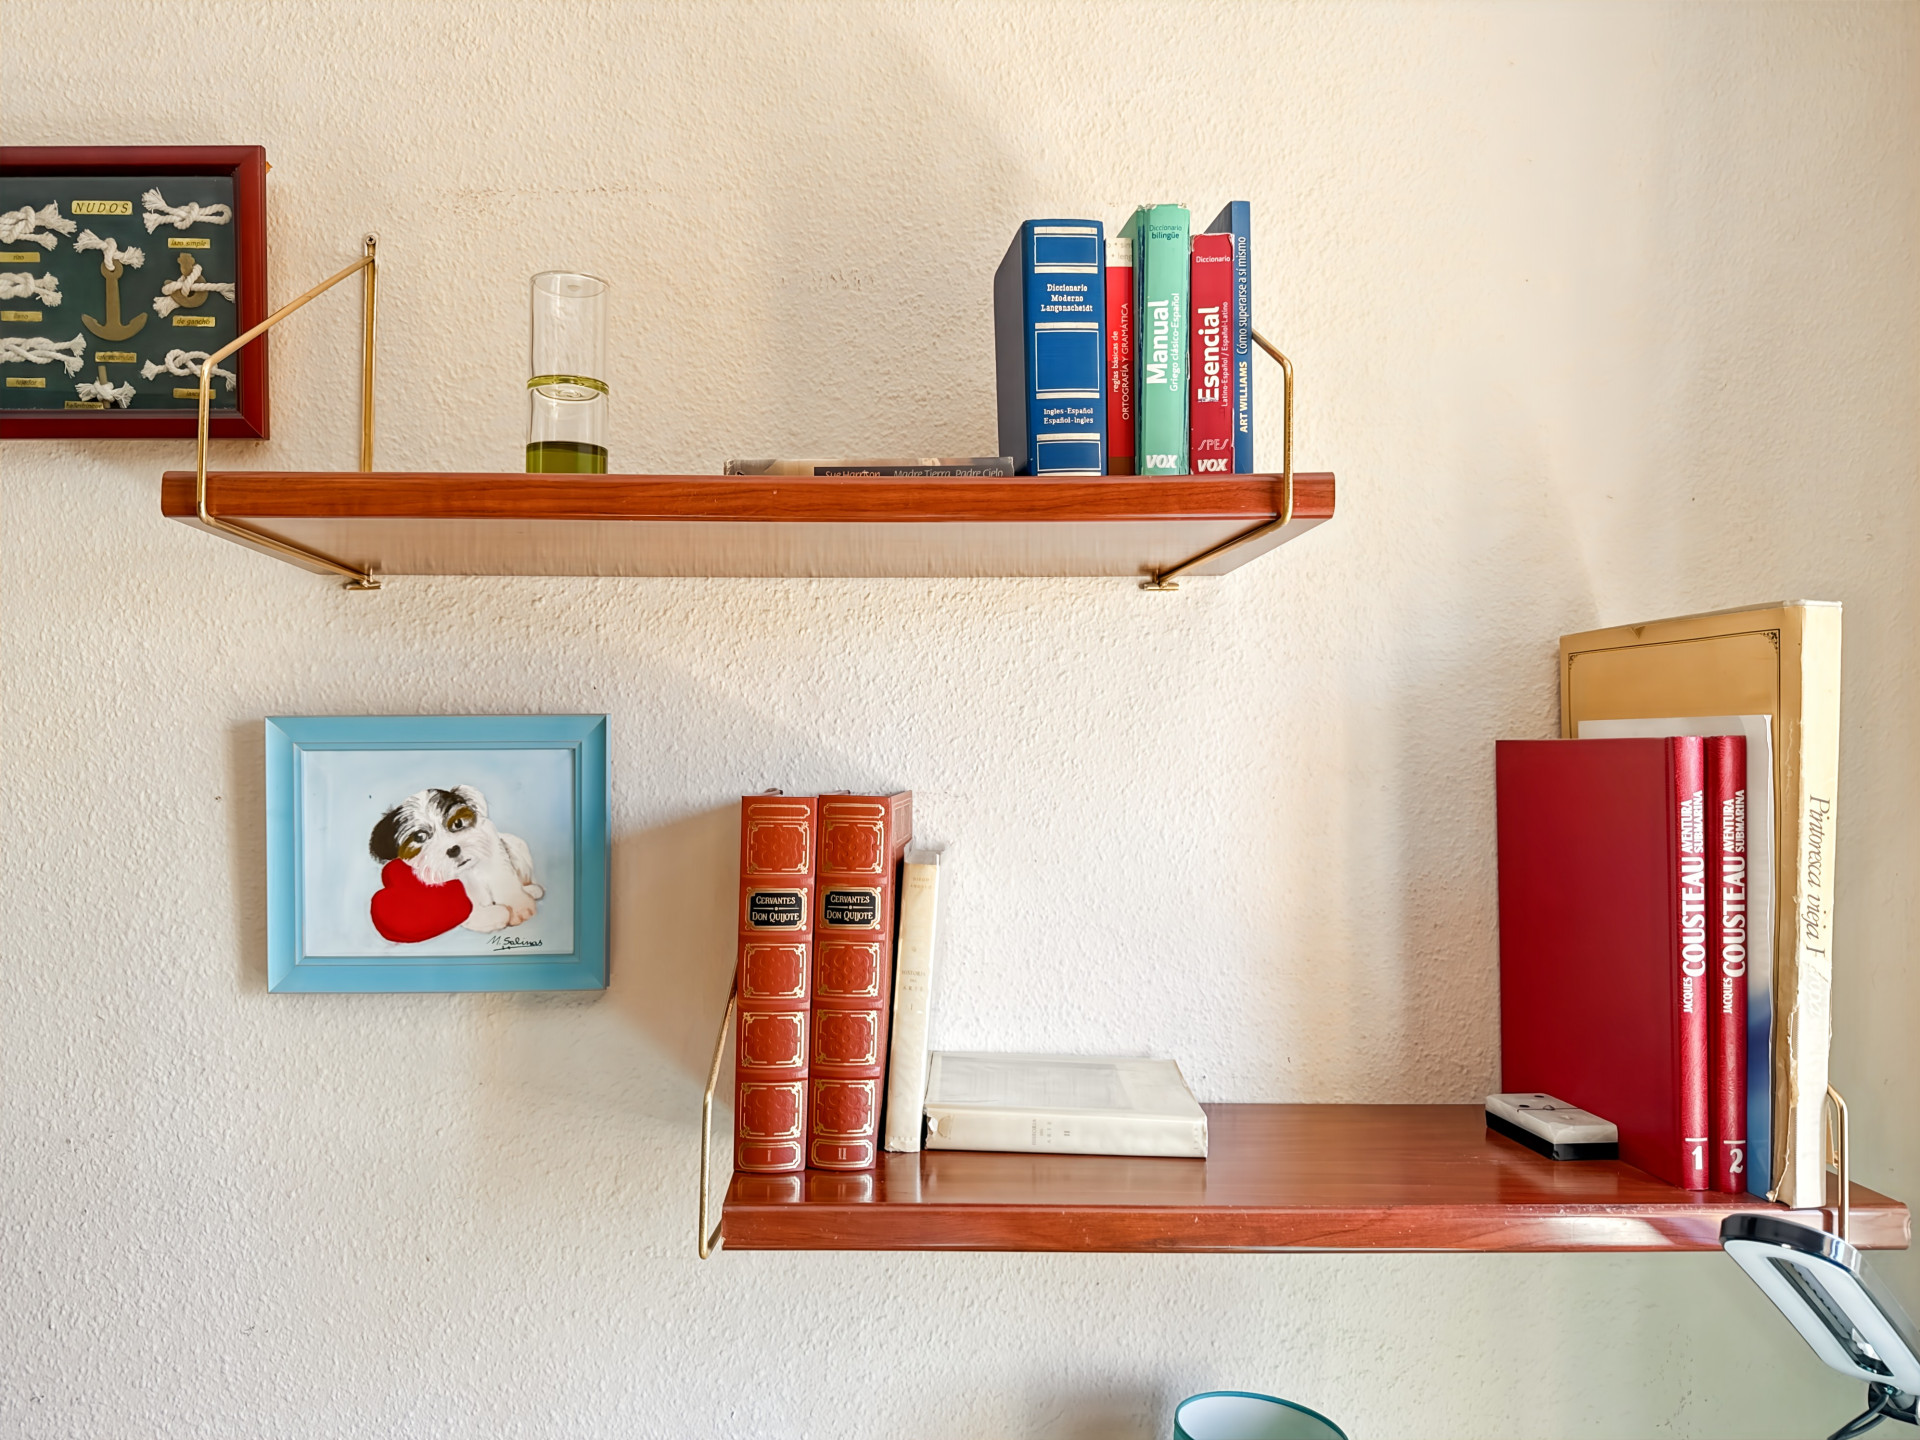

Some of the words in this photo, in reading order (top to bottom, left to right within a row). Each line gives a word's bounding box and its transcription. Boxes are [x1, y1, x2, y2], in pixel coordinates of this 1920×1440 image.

[74, 202, 129, 213] NUDOS
[1151, 232, 1180, 240] bilingüe
[1195, 256, 1231, 264] Diccionario
[1236, 236, 1247, 267] mismo
[1235, 267, 1247, 276] sí
[1046, 283, 1088, 292] Diccionario
[1050, 294, 1084, 302] Moderno
[1040, 303, 1093, 313] Langenscheidt
[1238, 284, 1250, 327] superarse
[1111, 330, 1119, 342] de
[1120, 302, 1129, 354] GRAMÁTICA
[1171, 292, 1182, 361] clásico-Español
[1220, 301, 1230, 351] Español-Latino
[1236, 325, 1248, 355] Cómo
[1111, 343, 1119, 369] básicas
[1146, 299, 1169, 385] Manual
[1197, 306, 1220, 402] Esencial
[1121, 355, 1129, 363] Y
[1112, 370, 1121, 393] reglas
[1169, 361, 1181, 392] Griego
[1220, 357, 1230, 407] Latino-Español
[1239, 360, 1248, 411] WILLIAMS
[1120, 364, 1130, 420] ORTOGRAFÍA
[1239, 412, 1249, 433] ART
[1197, 438, 1230, 451] SPES
[1146, 454, 1178, 469] VOX
[1197, 458, 1229, 472] VOX
[1681, 800, 1693, 854] AVENTURA
[1693, 790, 1704, 854] SUBMARINA
[1723, 798, 1735, 853] AVENTURA
[1735, 789, 1745, 853] SUBMARINA
[1808, 795, 1831, 887] Pintoresca
[755, 895, 796, 905] CERVANTES
[830, 894, 870, 904] CERVANTES
[752, 911, 768, 921] DON
[769, 911, 800, 923] QUIJOTE
[826, 910, 842, 919] DON
[843, 910, 874, 922] QUIJOTE
[1681, 857, 1706, 977] COUSTEAU
[1722, 856, 1746, 977] COUSTEAU
[1801, 893, 1827, 940] vieja
[1683, 976, 1693, 1014] JACQUES
[1723, 976, 1733, 1014] JACQUES
[1692, 1145, 1704, 1170] 1
[1729, 1148, 1744, 1173] 2
